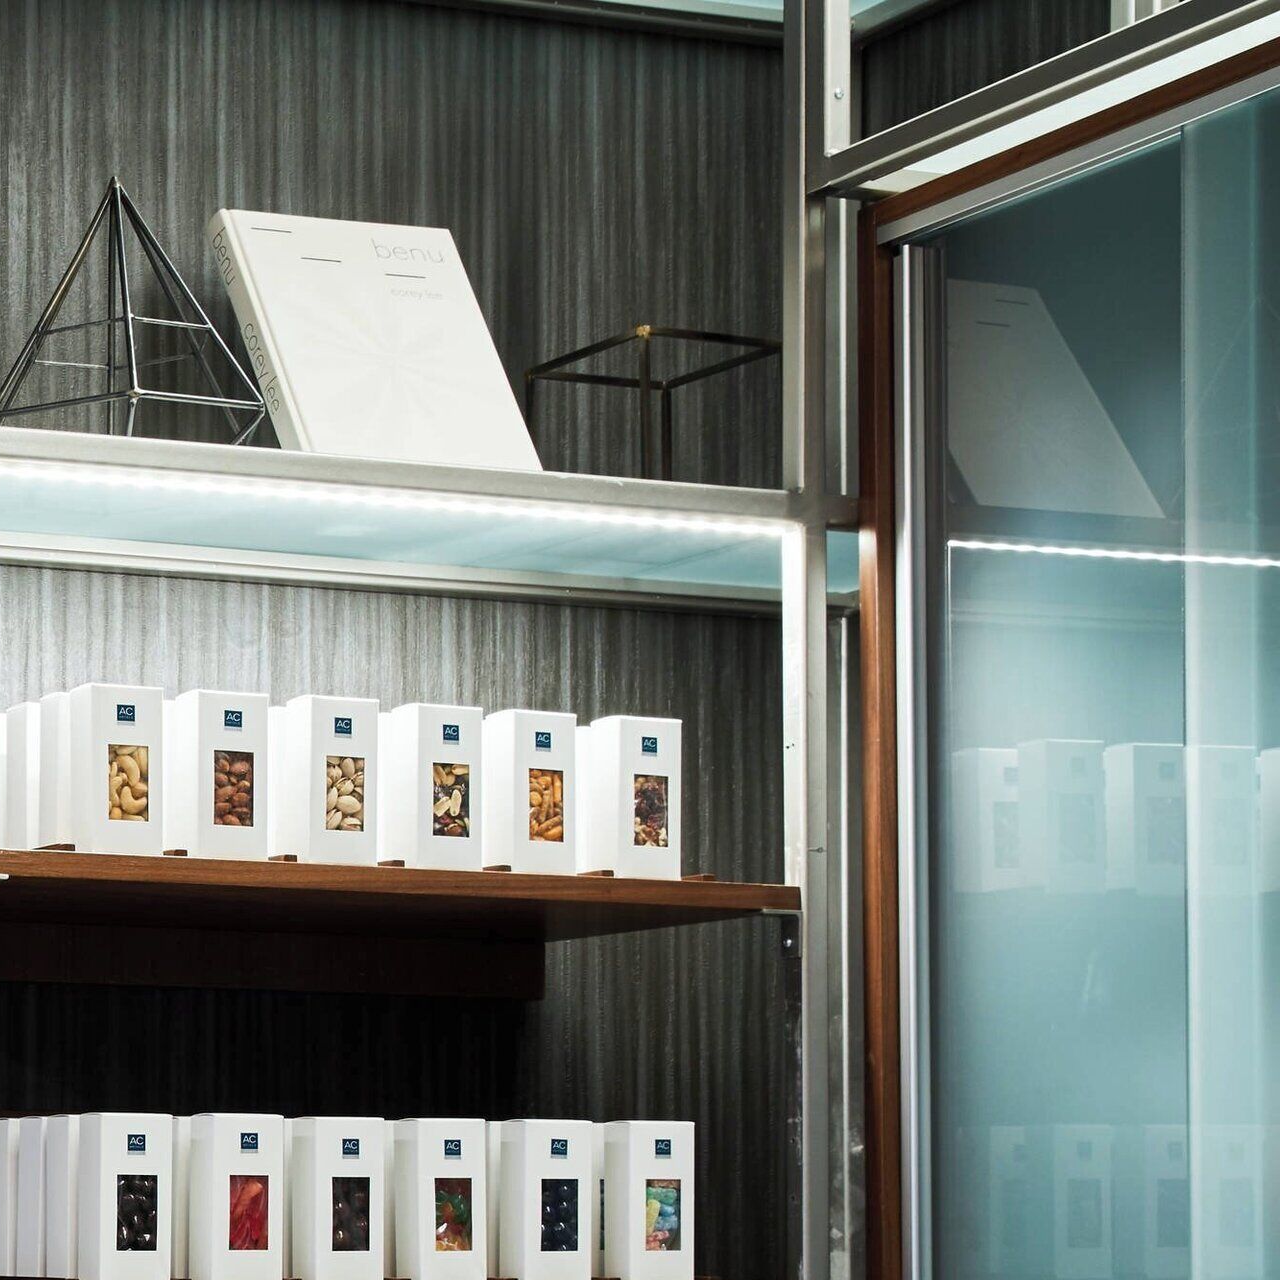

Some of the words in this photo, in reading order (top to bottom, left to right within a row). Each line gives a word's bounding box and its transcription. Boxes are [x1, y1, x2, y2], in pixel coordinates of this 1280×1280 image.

[371, 238, 444, 264] benu
[212, 227, 236, 287] benu
[244, 322, 270, 382] corey
[264, 375, 280, 416] lee
[119, 707, 134, 716] AC
[226, 712, 241, 722] AC
[337, 719, 352, 729] AC
[444, 727, 458, 736] AC
[537, 734, 550, 743] AC
[643, 739, 657, 748] AC
[129, 1136, 144, 1145] AC
[242, 1135, 257, 1144] AC
[344, 1141, 358, 1150] AC
[446, 1141, 460, 1150] AC
[552, 1141, 566, 1150] AC
[657, 1141, 671, 1150] AC
